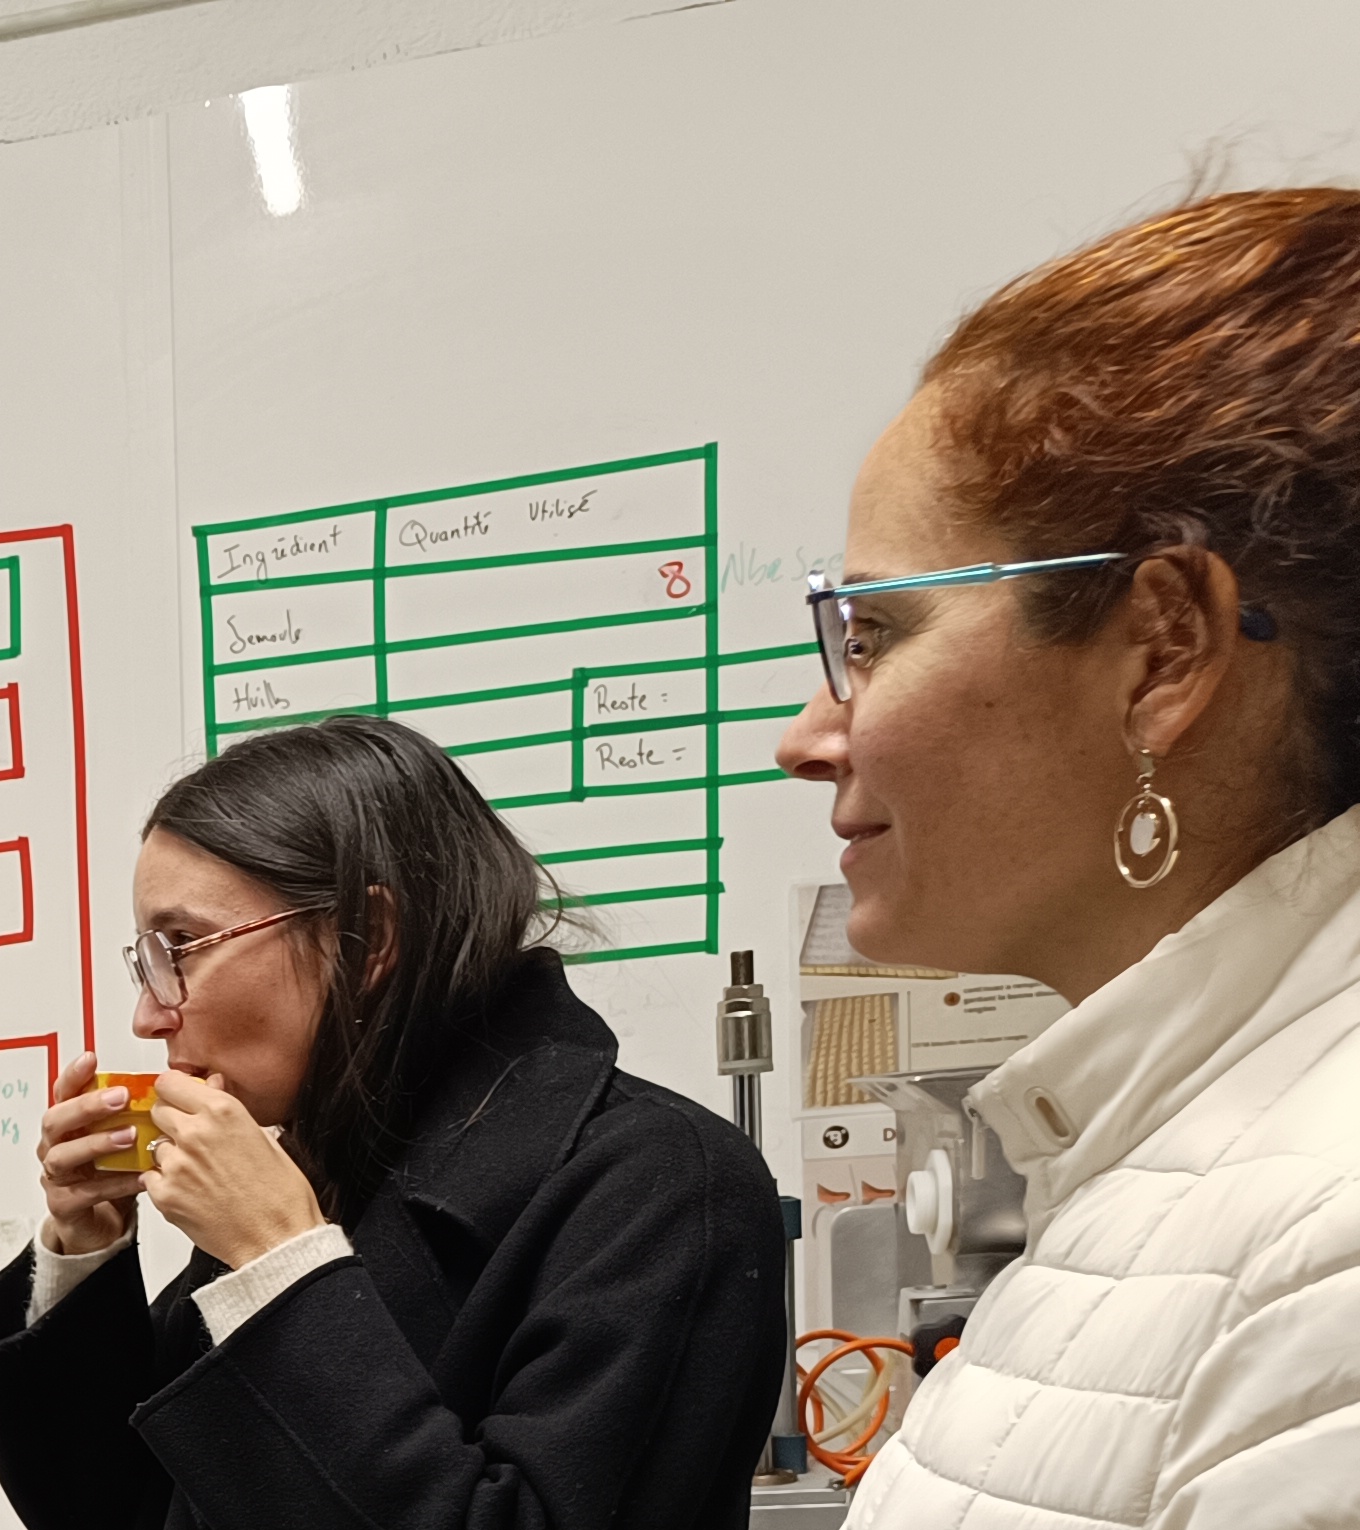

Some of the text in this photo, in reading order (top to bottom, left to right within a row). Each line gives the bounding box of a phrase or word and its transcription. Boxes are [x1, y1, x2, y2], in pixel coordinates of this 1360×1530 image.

[657, 561, 691, 599] 8
[593, 682, 647, 714] Reste
[595, 738, 664, 770] Reste
